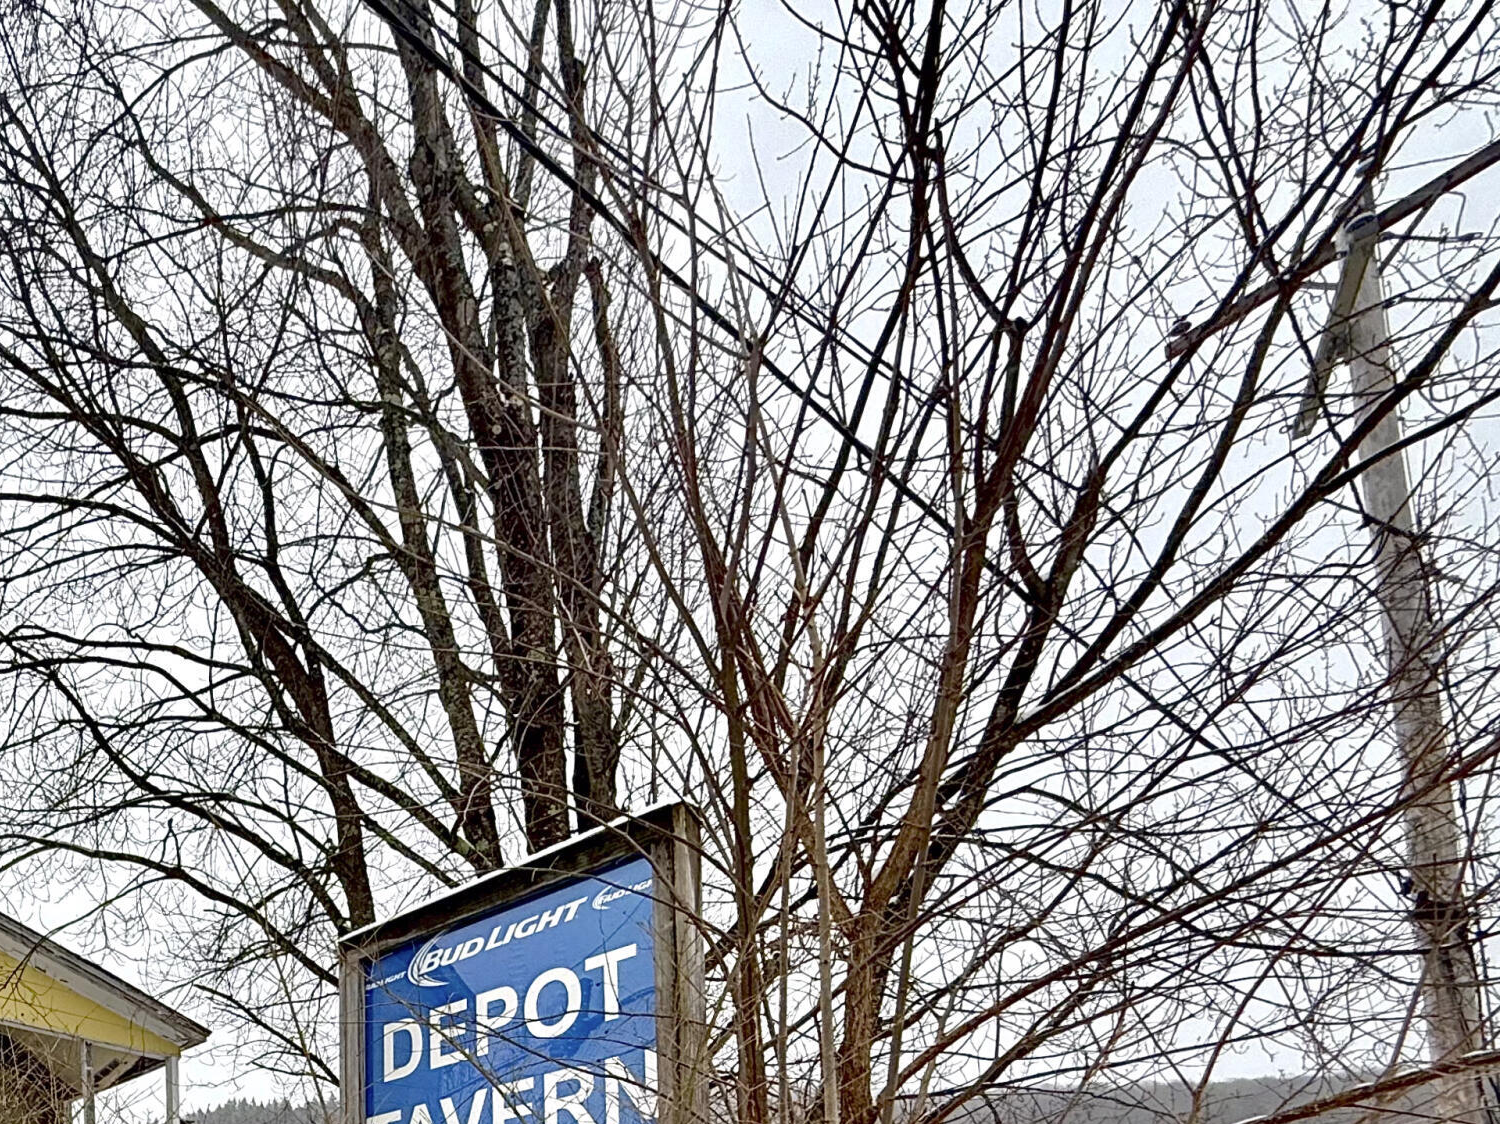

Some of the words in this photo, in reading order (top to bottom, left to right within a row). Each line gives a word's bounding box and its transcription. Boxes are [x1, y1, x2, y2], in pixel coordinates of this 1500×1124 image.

[419, 937, 486, 976] BUD
[484, 895, 589, 951] LIGHT
[383, 943, 638, 1084] DEPOT
